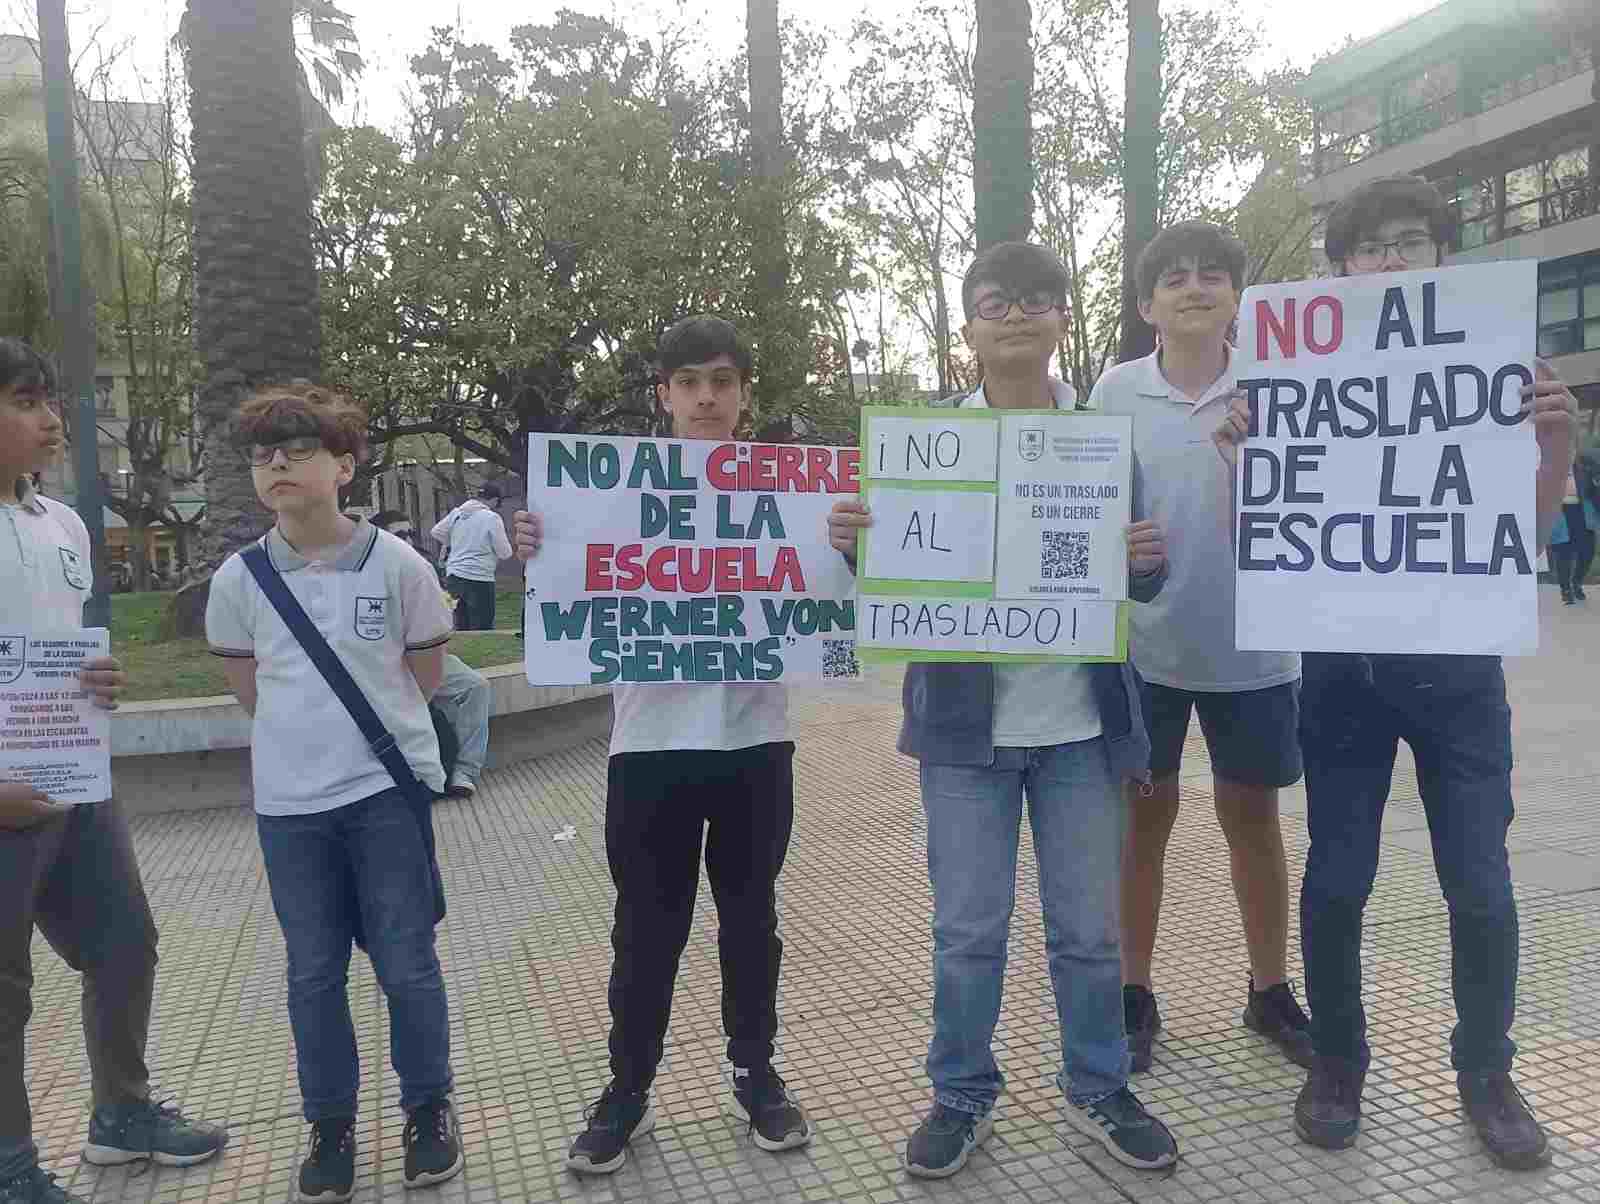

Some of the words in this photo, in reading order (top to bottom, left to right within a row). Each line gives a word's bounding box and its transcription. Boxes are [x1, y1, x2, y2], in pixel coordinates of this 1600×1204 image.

[1255, 295, 1344, 361] NO
[1375, 281, 1466, 350] AL
[1237, 363, 1535, 438] TRASLADO
[546, 439, 621, 490] NO
[627, 442, 699, 491] AL
[1242, 445, 1327, 506] DE
[1378, 444, 1474, 508] LA
[1015, 483, 1030, 498] NO
[1032, 484, 1045, 498] ES
[1047, 484, 1061, 498] UN
[1063, 484, 1119, 499] TRASLADO
[1031, 504, 1045, 519] ES
[1046, 505, 1061, 519] UN
[1063, 505, 1102, 520] CIERRE
[640, 492, 697, 541] DE
[716, 494, 787, 540] LA
[901, 510, 953, 553] AL
[585, 543, 806, 593] ESCUELA
[1238, 511, 1533, 576] ESCUELA
[760, 597, 856, 637] VON
[870, 603, 1077, 645] TRASLADO!
